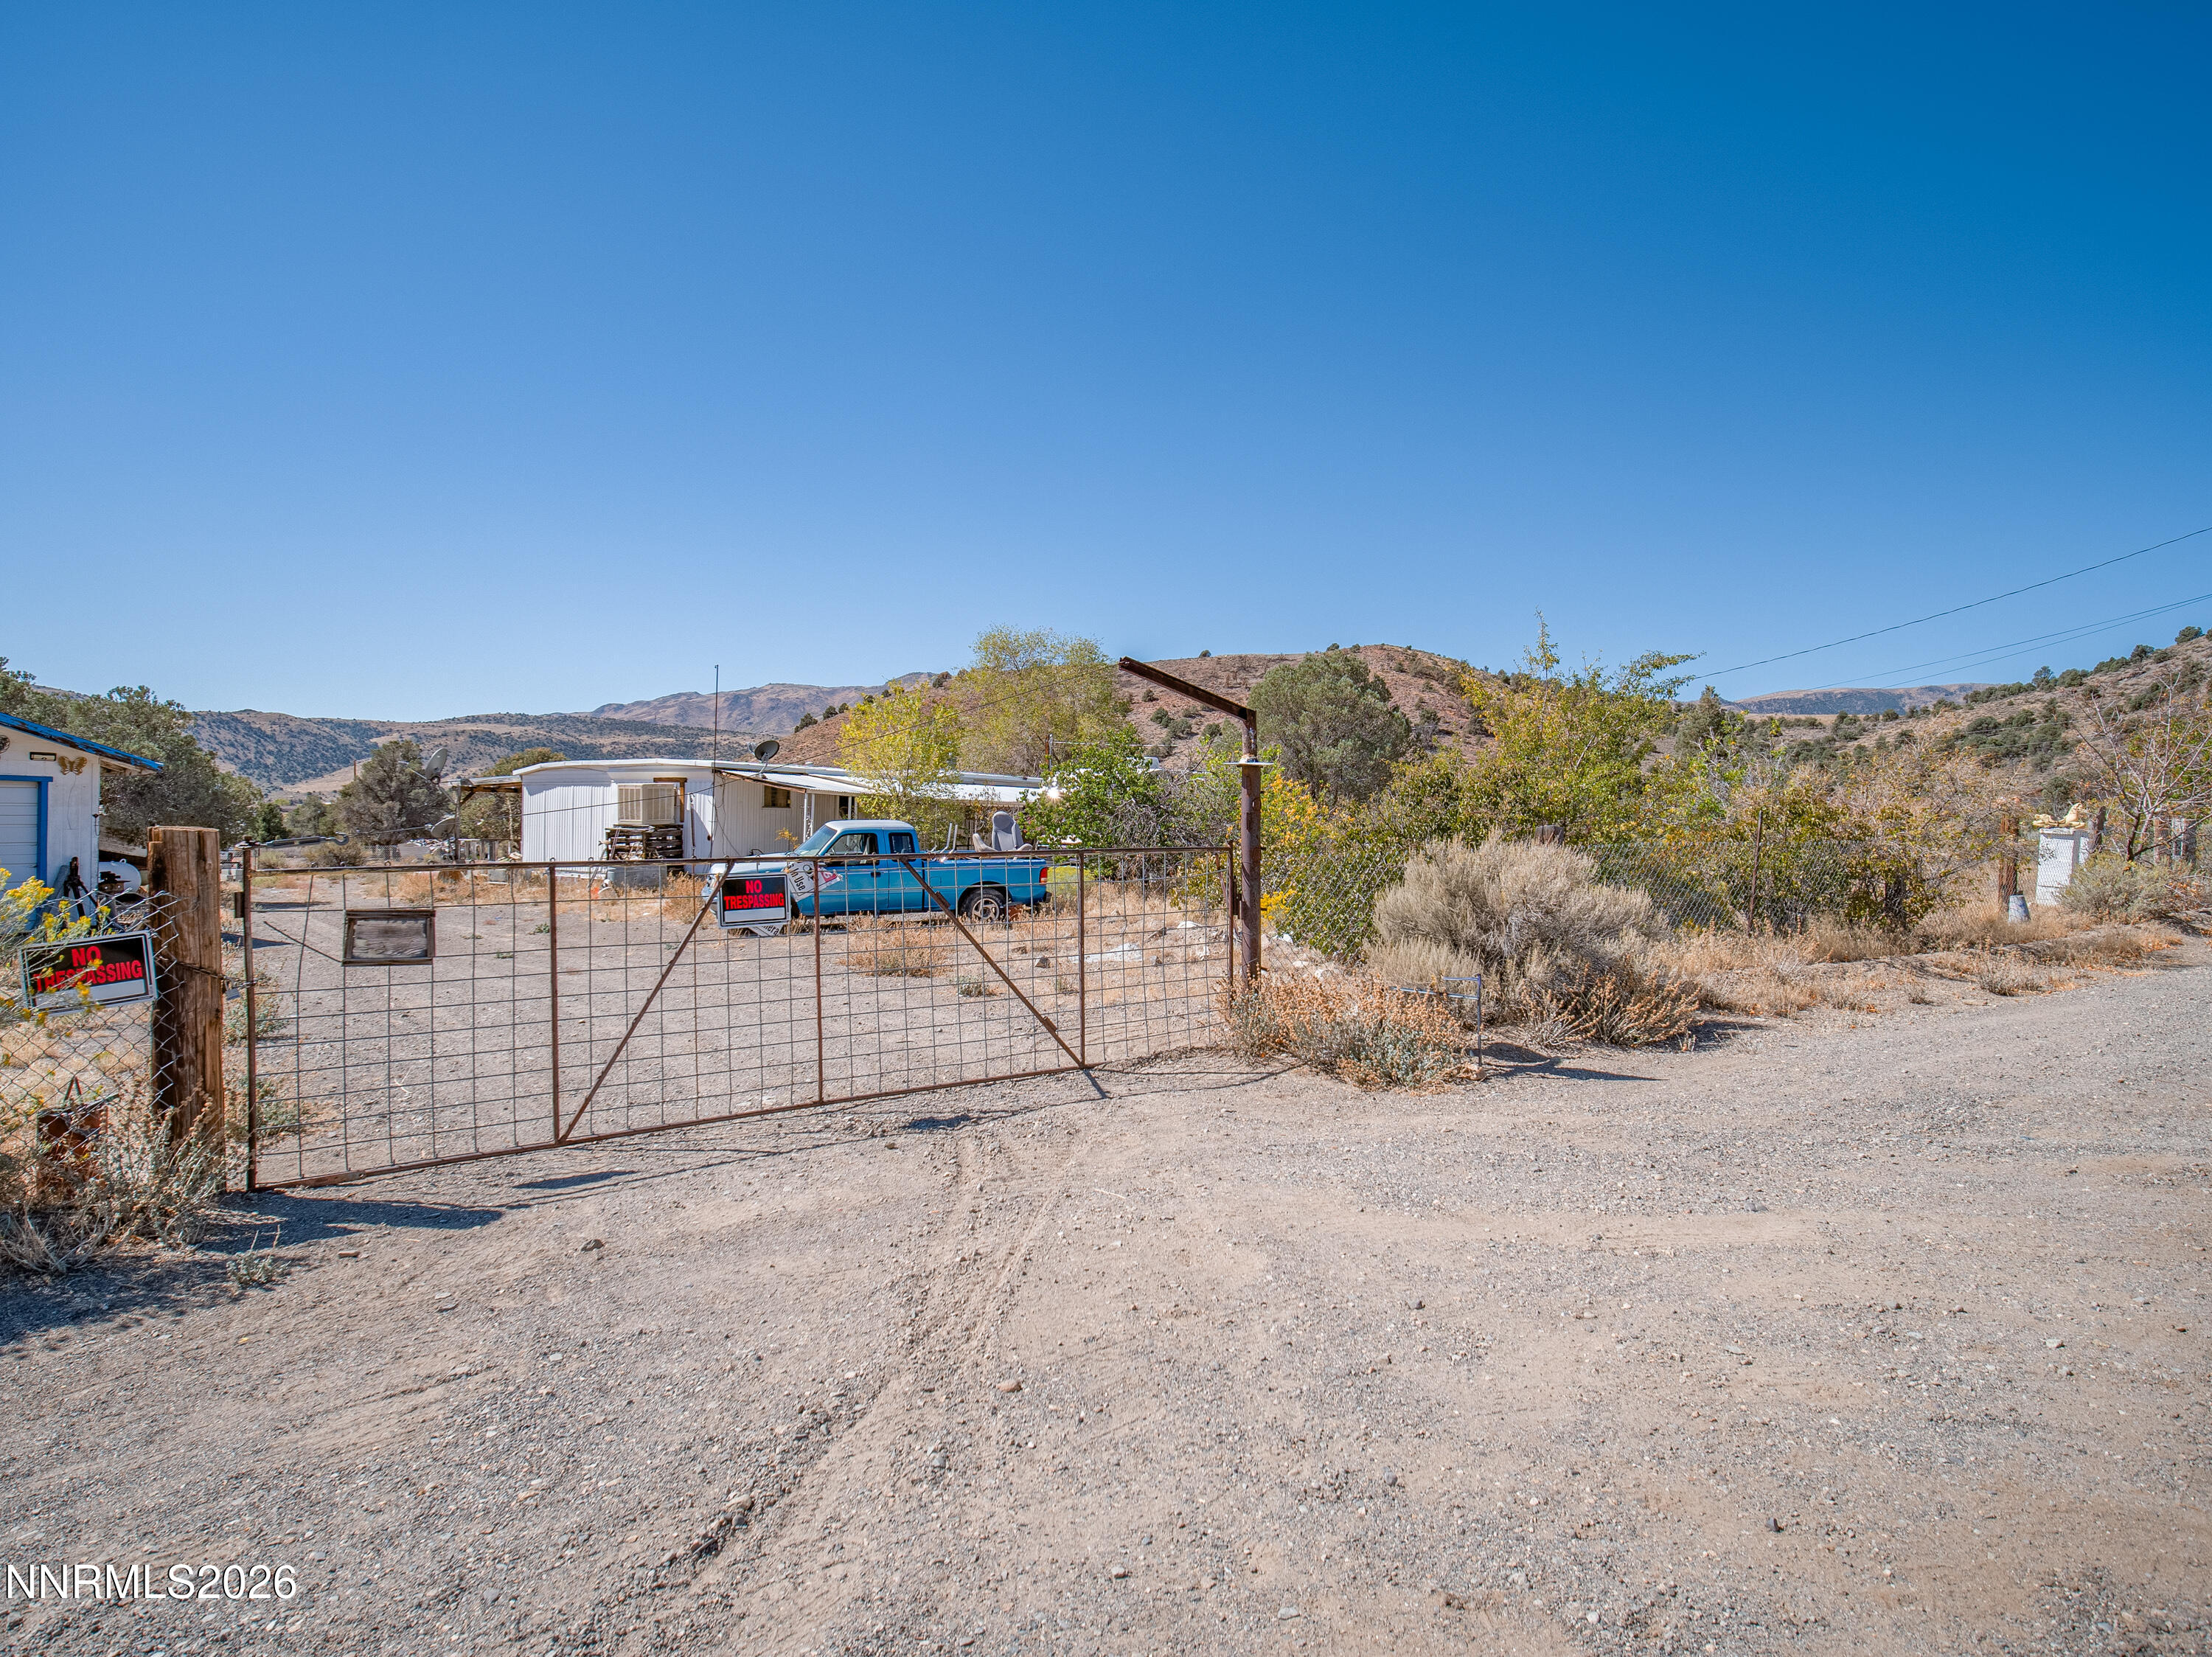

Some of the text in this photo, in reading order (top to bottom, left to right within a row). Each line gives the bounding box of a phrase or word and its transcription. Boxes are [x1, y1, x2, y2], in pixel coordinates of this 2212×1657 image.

[745, 880, 763, 894] NO
[794, 876, 806, 891] Use
[723, 893, 785, 910] TRESPASSING
[72, 946, 101, 967] NO
